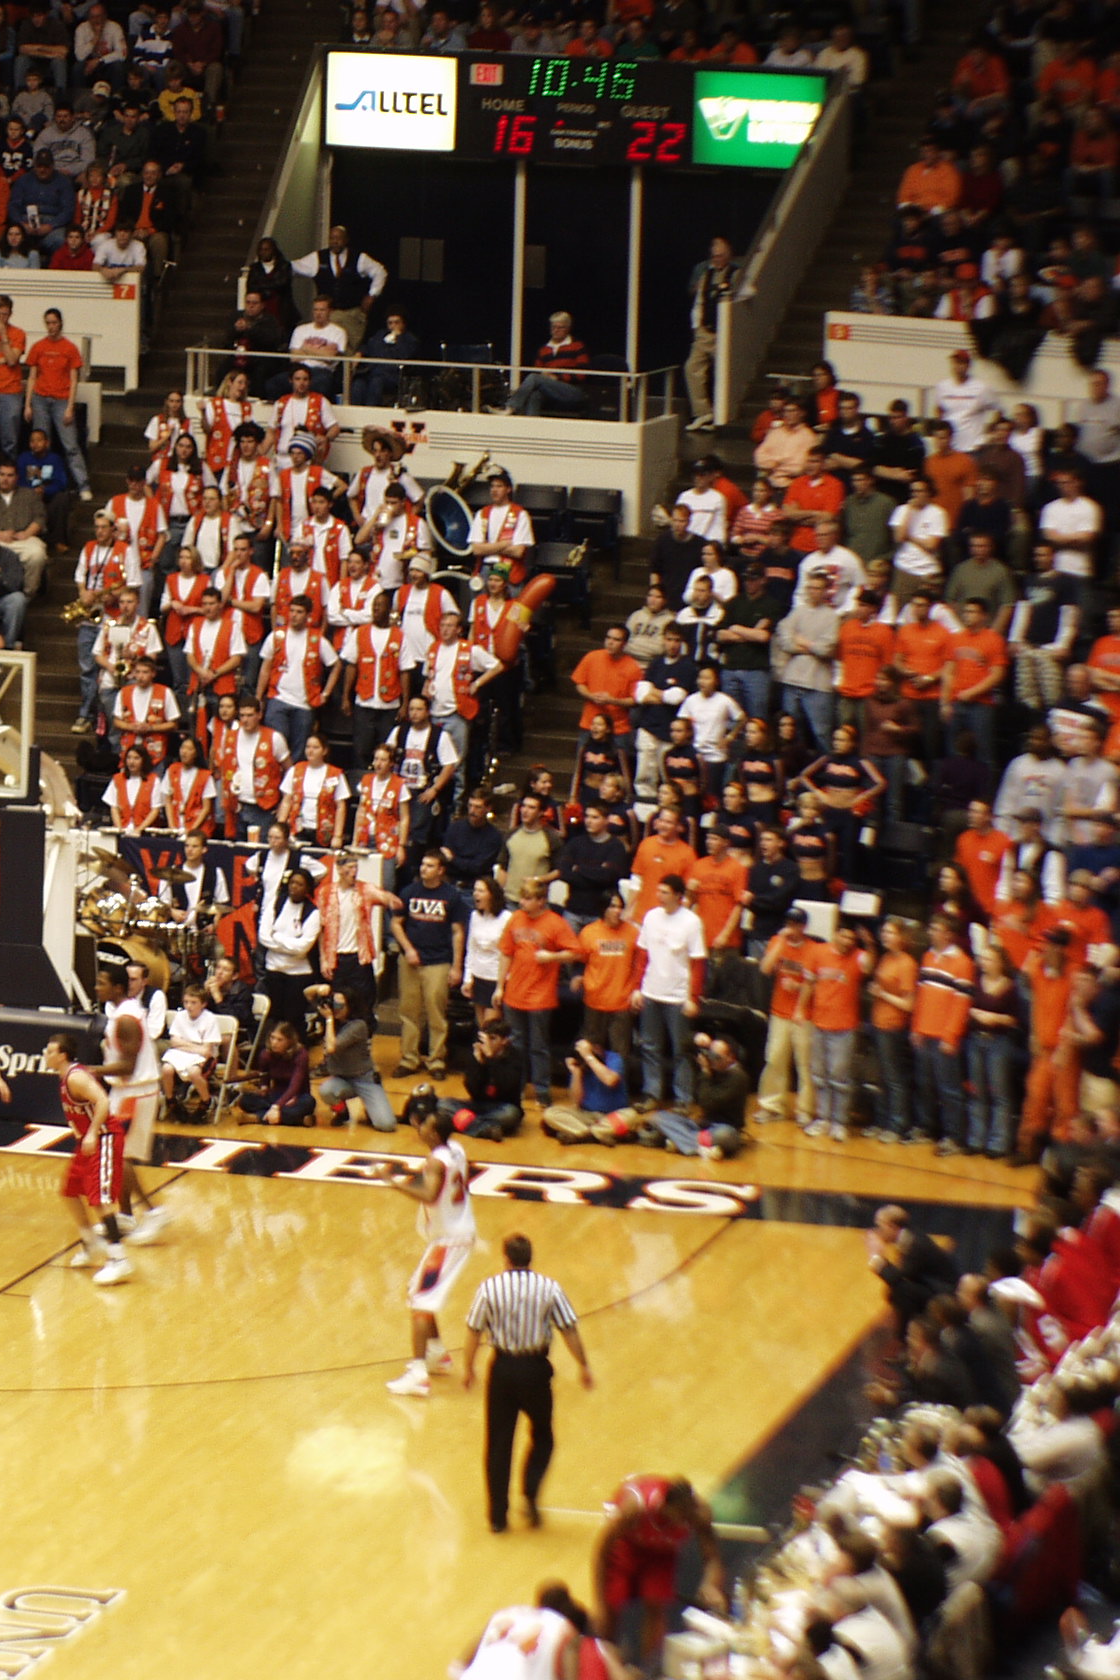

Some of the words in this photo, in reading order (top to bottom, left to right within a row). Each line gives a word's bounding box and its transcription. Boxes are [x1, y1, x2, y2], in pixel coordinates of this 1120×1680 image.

[335, 90, 448, 116] ALLTEL
[482, 98, 526, 112] HOME
[620, 105, 671, 119] GUEST
[493, 115, 538, 153] 16
[626, 121, 688, 162] 22
[554, 138, 594, 150] BONUS
[120, 285, 130, 298] 7
[408, 898, 446, 917] UVA
